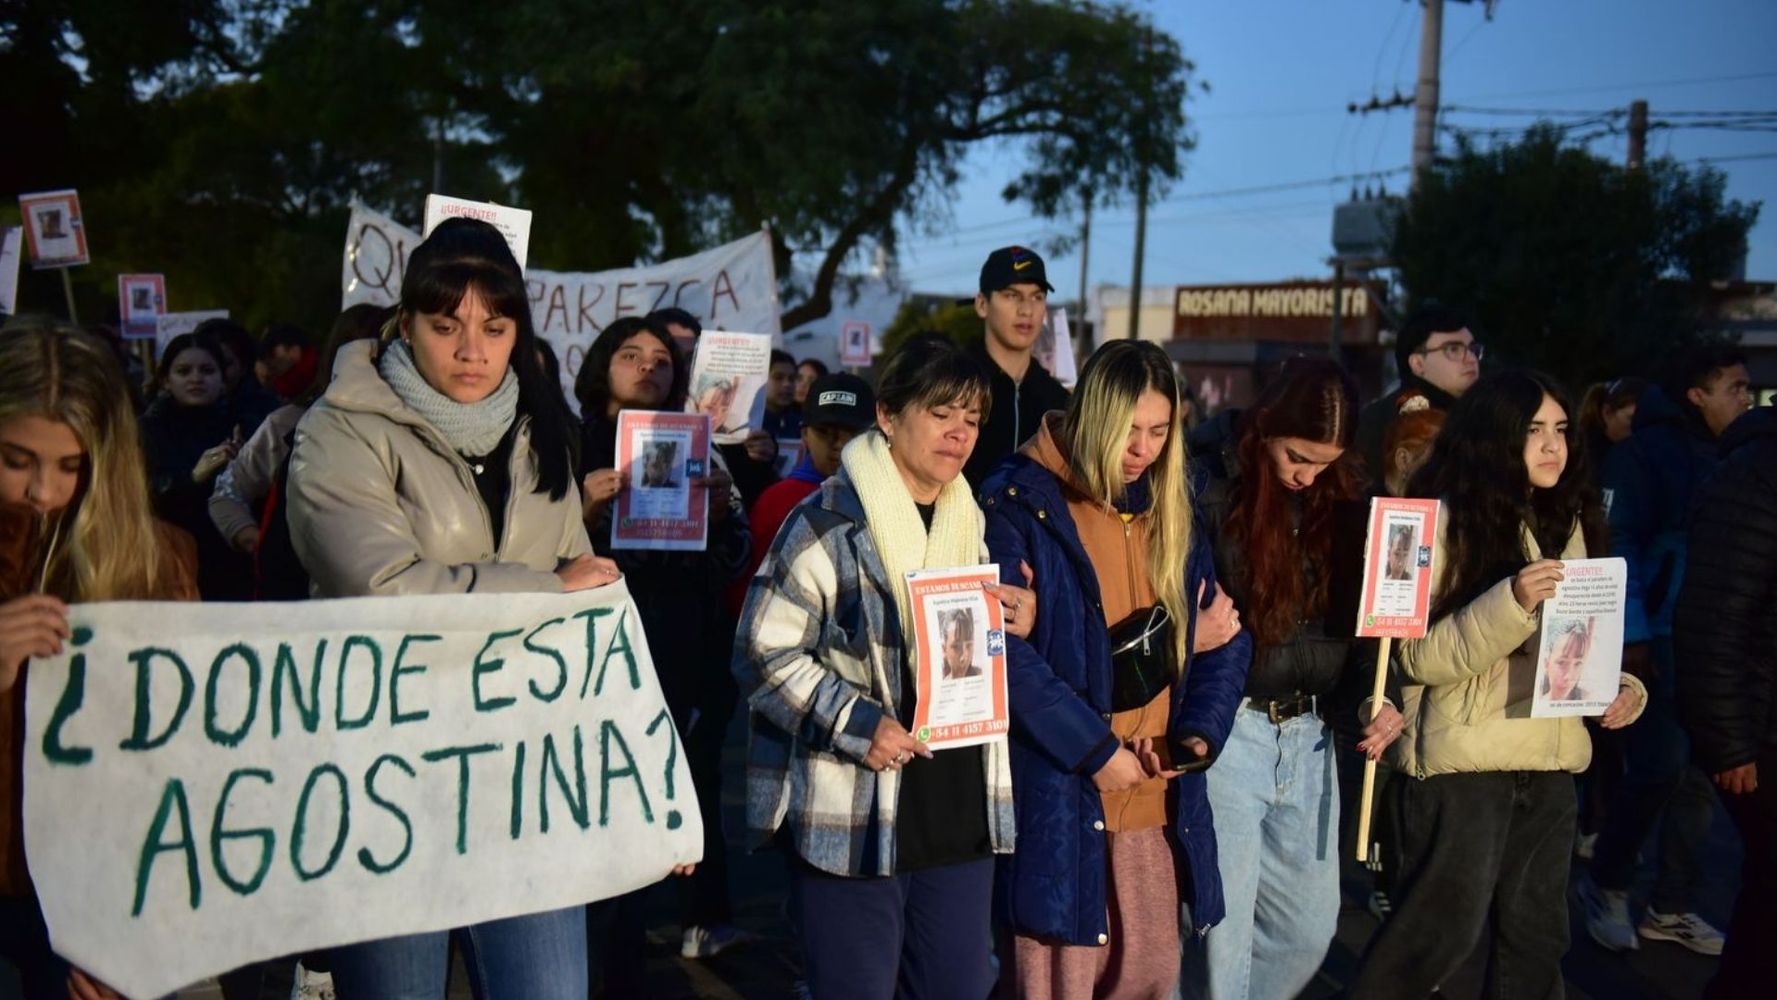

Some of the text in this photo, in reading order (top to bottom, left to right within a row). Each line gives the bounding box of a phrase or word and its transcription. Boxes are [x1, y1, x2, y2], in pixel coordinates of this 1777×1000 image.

[1179, 287, 1368, 317] ROSANA MAYORISTA
[822, 393, 854, 402] CAPTAIN
[42, 605, 642, 765] ¿DONDE ESTA
[130, 706, 684, 918] AGOSTINA?
